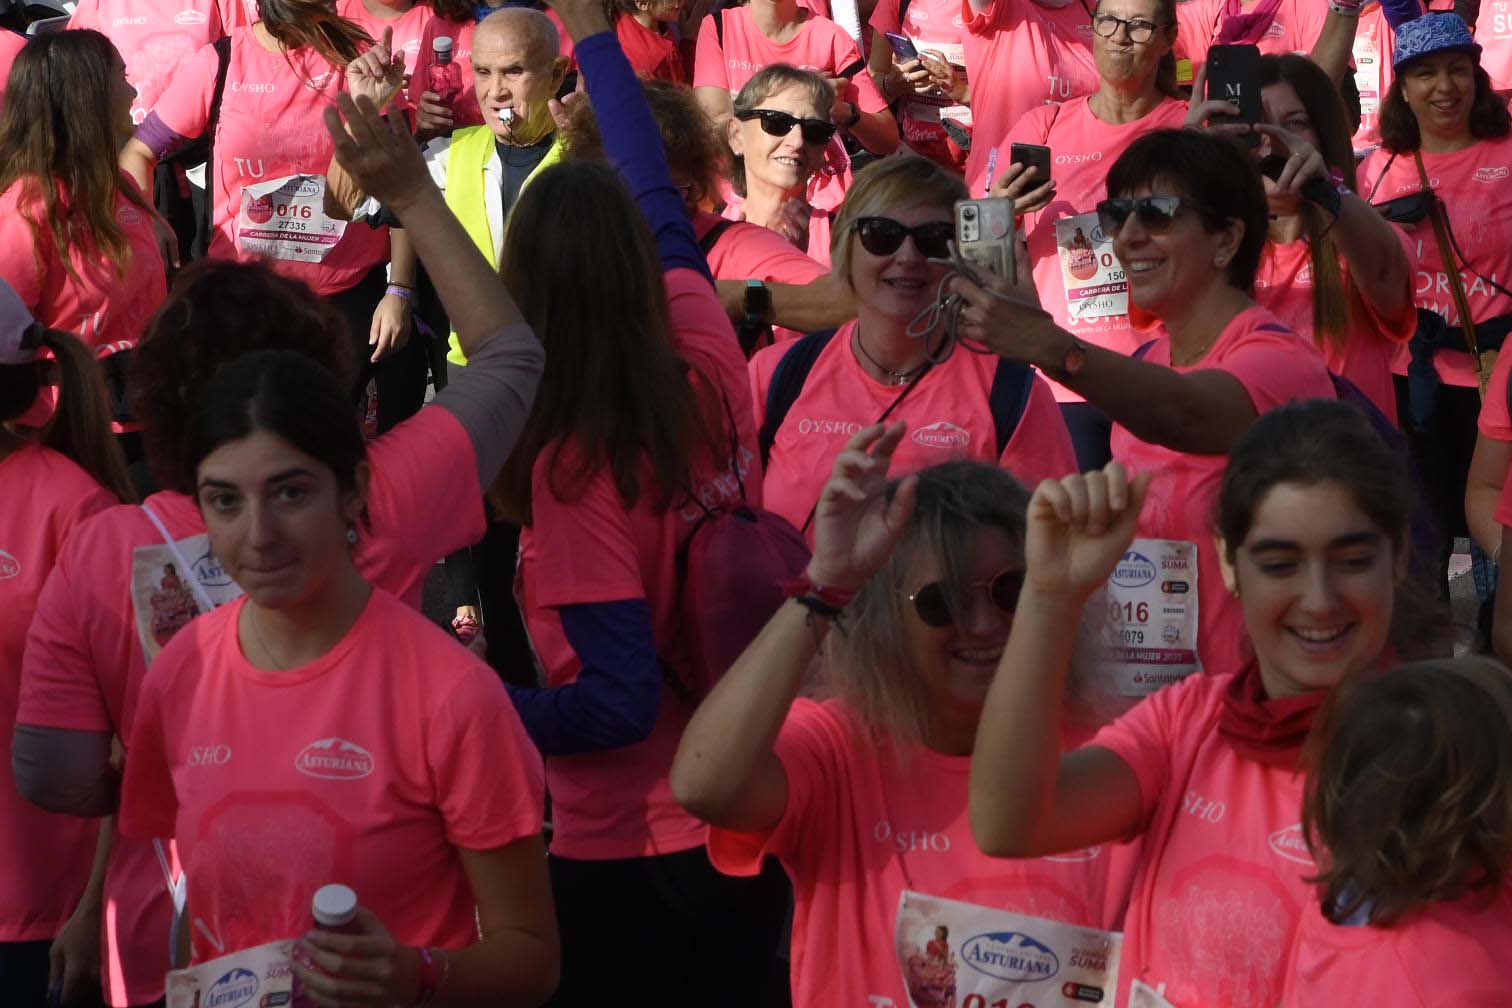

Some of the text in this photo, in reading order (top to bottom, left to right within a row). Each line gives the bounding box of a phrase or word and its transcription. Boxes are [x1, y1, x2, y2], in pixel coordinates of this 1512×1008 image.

[1048, 76, 1071, 97] TU
[1056, 152, 1102, 165] OYSHO
[233, 157, 264, 178] TU
[277, 203, 312, 218] 016
[278, 221, 306, 231] 27335
[1080, 286, 1111, 295] CARRERA
[799, 417, 864, 436] OYSHO
[1161, 560, 1188, 570] SUMA
[1110, 600, 1149, 623] 016
[1136, 653, 1161, 661] MUJER
[873, 820, 951, 853] OSHO
[969, 943, 1051, 975] ASTURIANA
